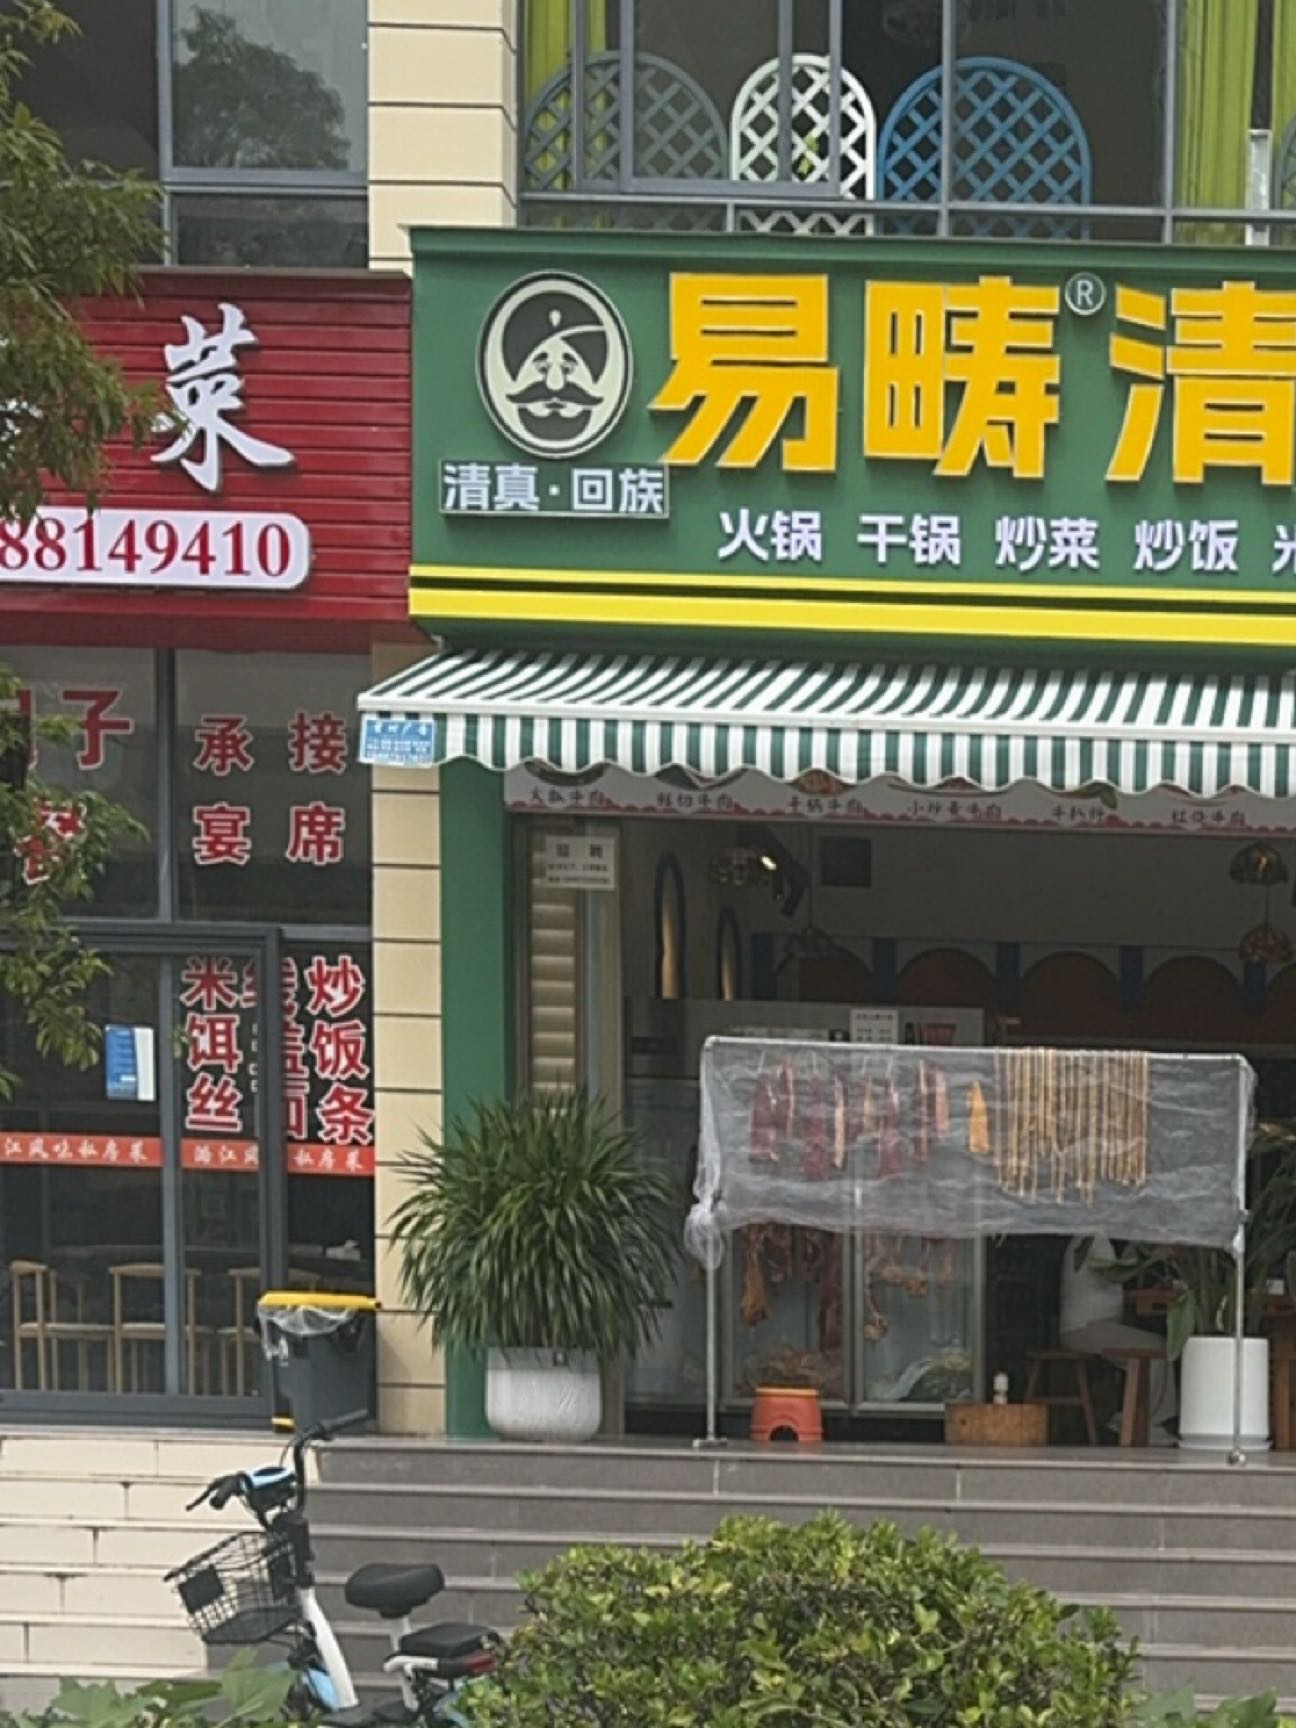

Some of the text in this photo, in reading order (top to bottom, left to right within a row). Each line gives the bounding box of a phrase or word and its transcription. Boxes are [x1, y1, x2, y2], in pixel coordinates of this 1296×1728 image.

[151, 302, 295, 492] 菜
[0, 518, 291, 577] 88149410
[718, 508, 823, 563] 火锅
[857, 513, 962, 567] 干锅
[994, 516, 1100, 571] 炒菜
[1133, 519, 1239, 574] 炒饭
